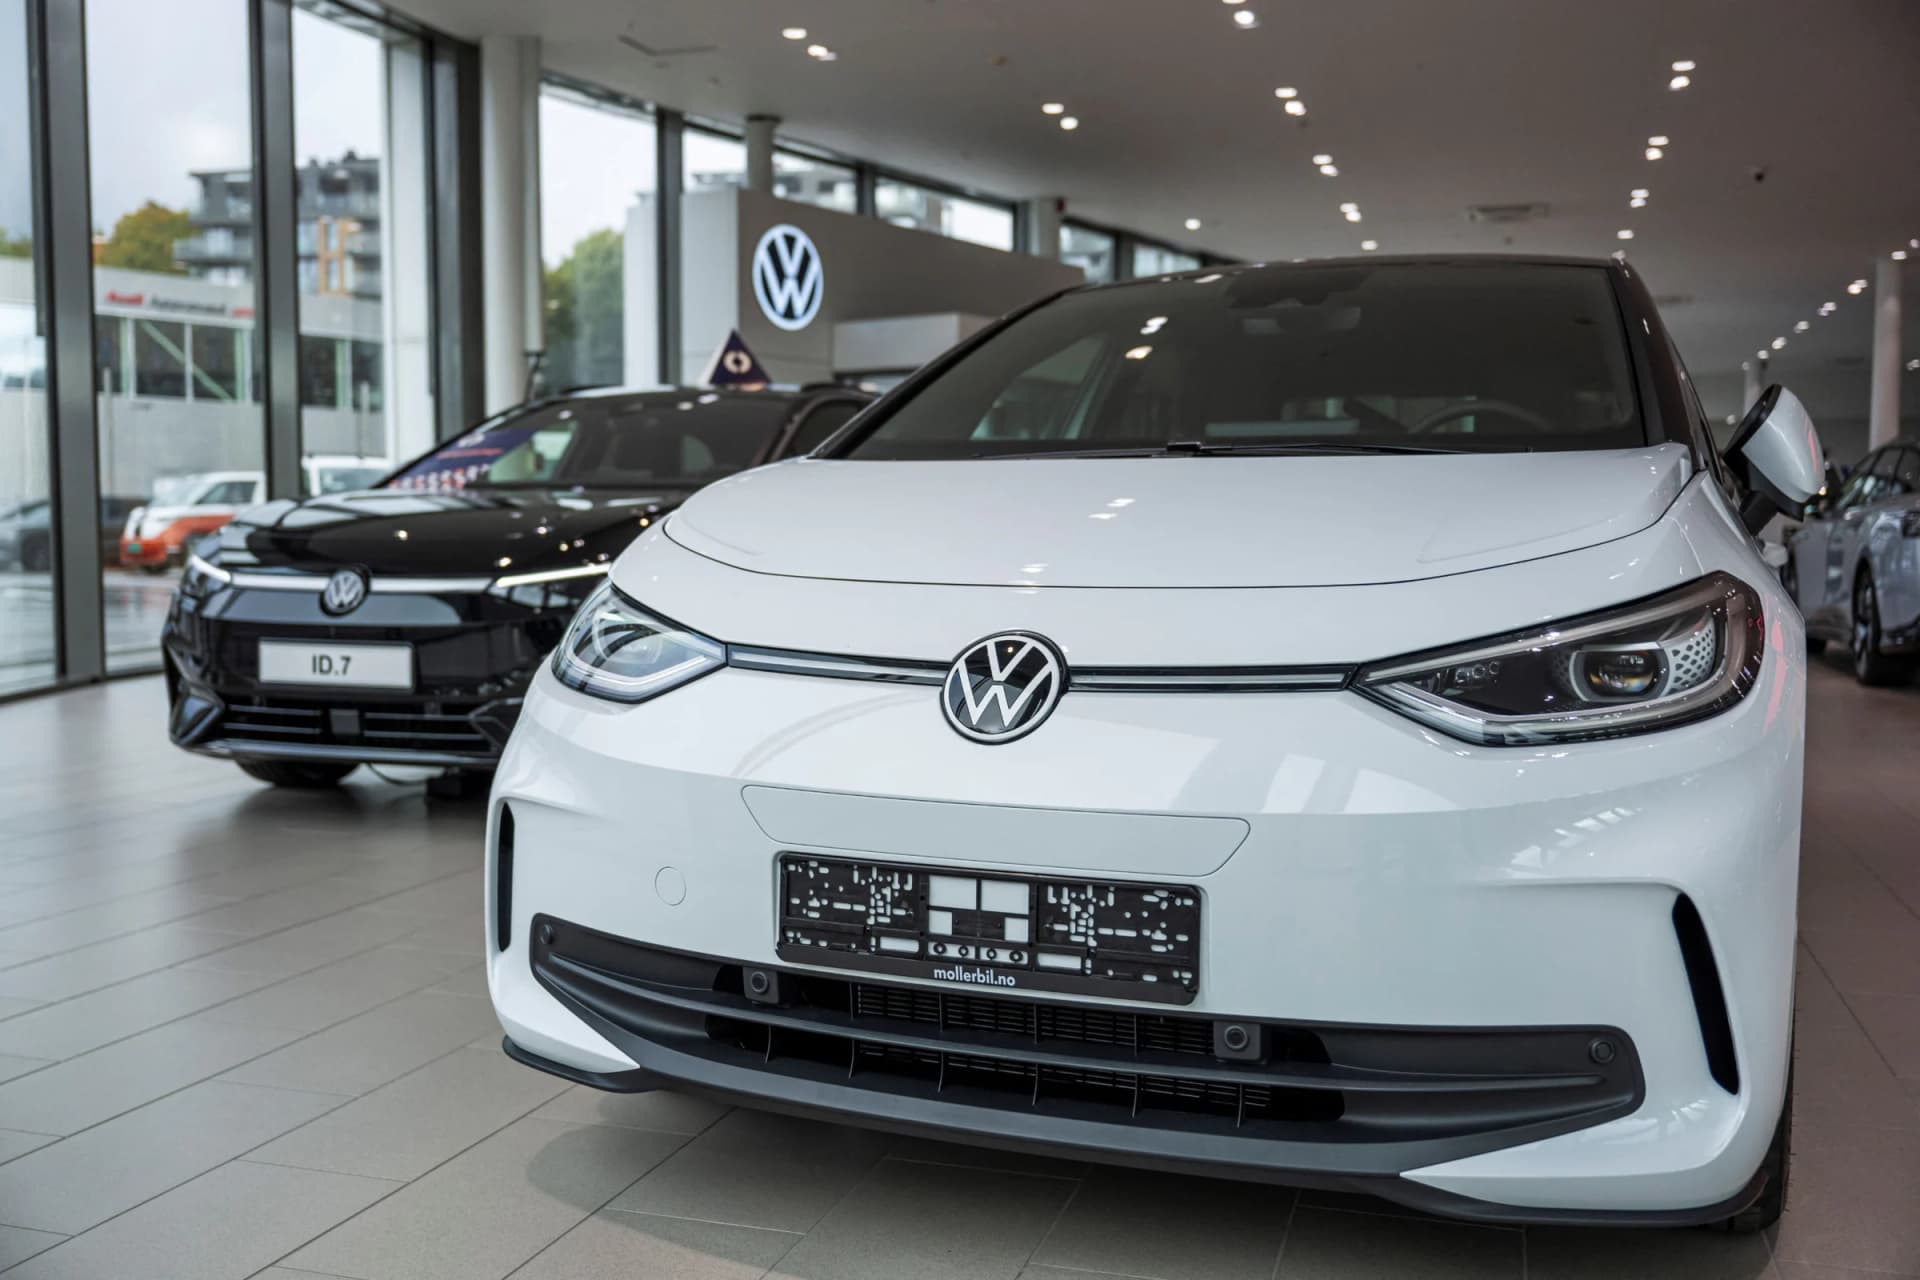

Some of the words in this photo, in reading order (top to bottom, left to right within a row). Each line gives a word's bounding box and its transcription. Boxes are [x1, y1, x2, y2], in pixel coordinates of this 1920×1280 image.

[756, 227, 821, 323] VW
[327, 571, 364, 609] VW
[311, 654, 352, 676] ID.7
[950, 636, 1058, 732] VW
[934, 965, 1016, 986] mollerbil.no
